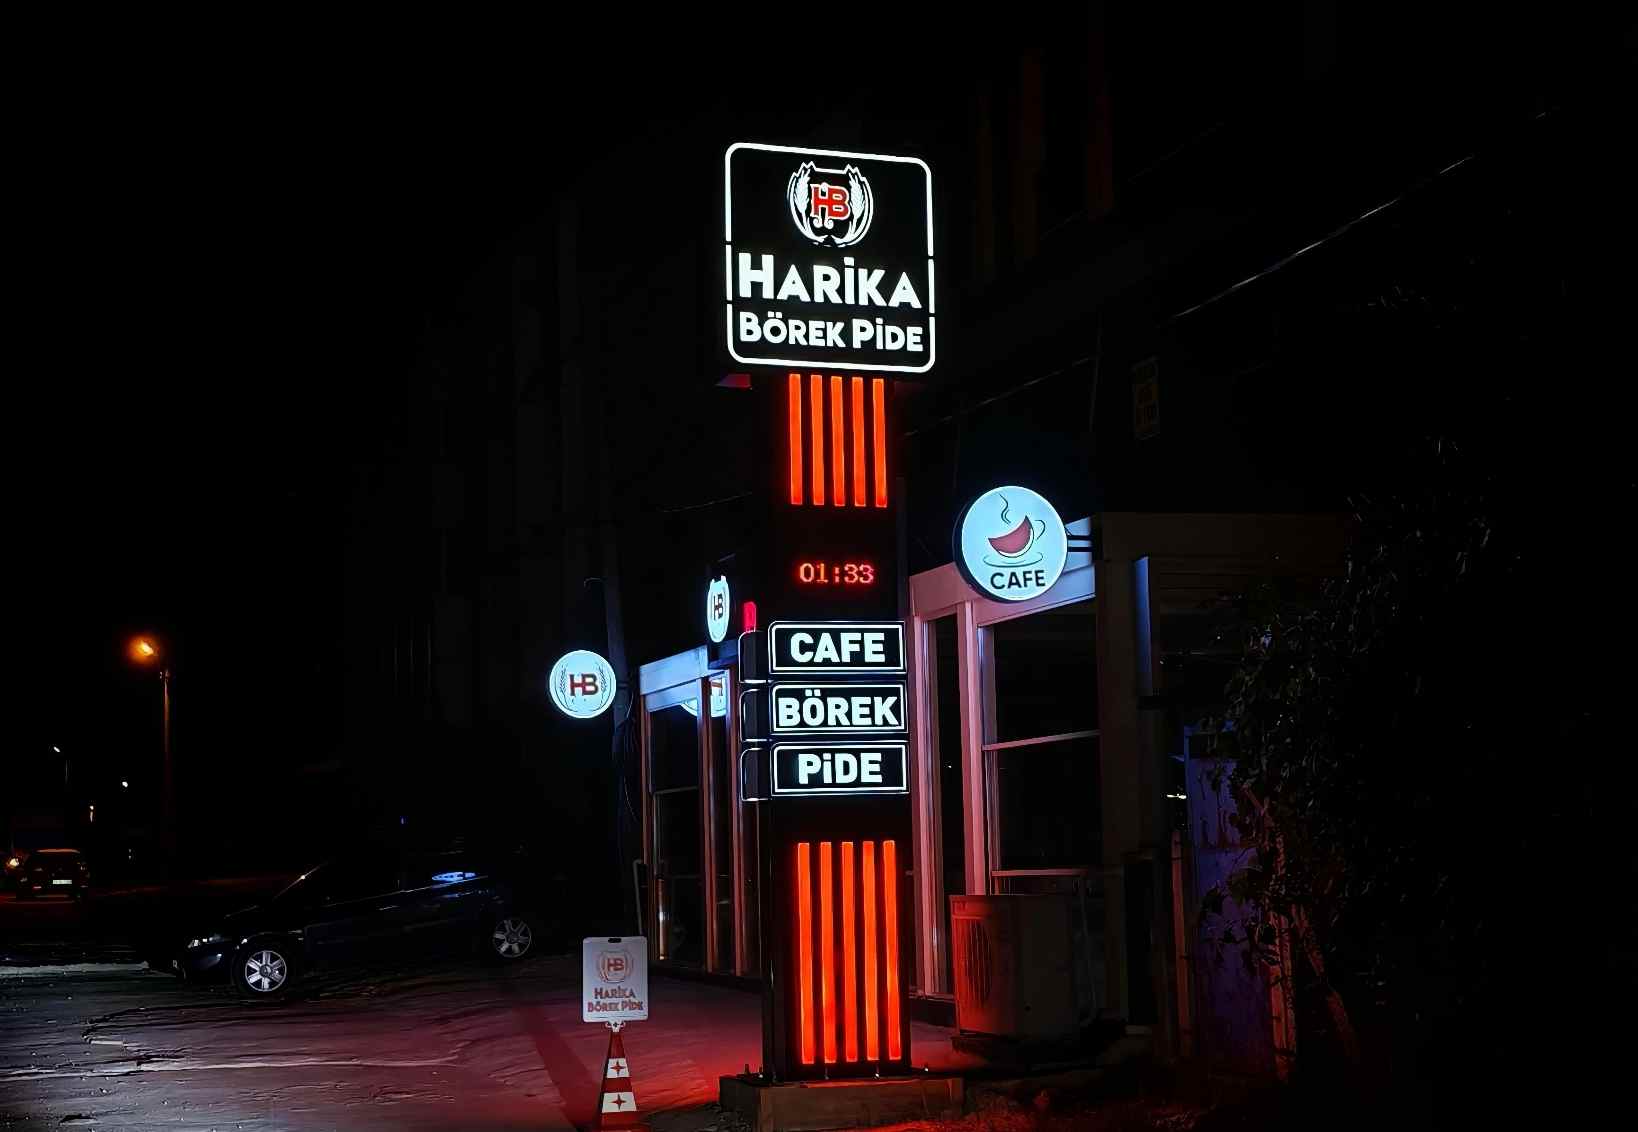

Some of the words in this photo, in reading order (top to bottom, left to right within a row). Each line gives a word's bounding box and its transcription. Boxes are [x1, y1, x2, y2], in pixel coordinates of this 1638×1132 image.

[810, 183, 851, 220] HB
[739, 311, 846, 348] BÖREK
[800, 563, 875, 584] 01:33
[990, 569, 1046, 590] CAFE
[790, 632, 886, 663] CAFE
[569, 673, 599, 697] HB
[777, 689, 899, 727] BÖREK
